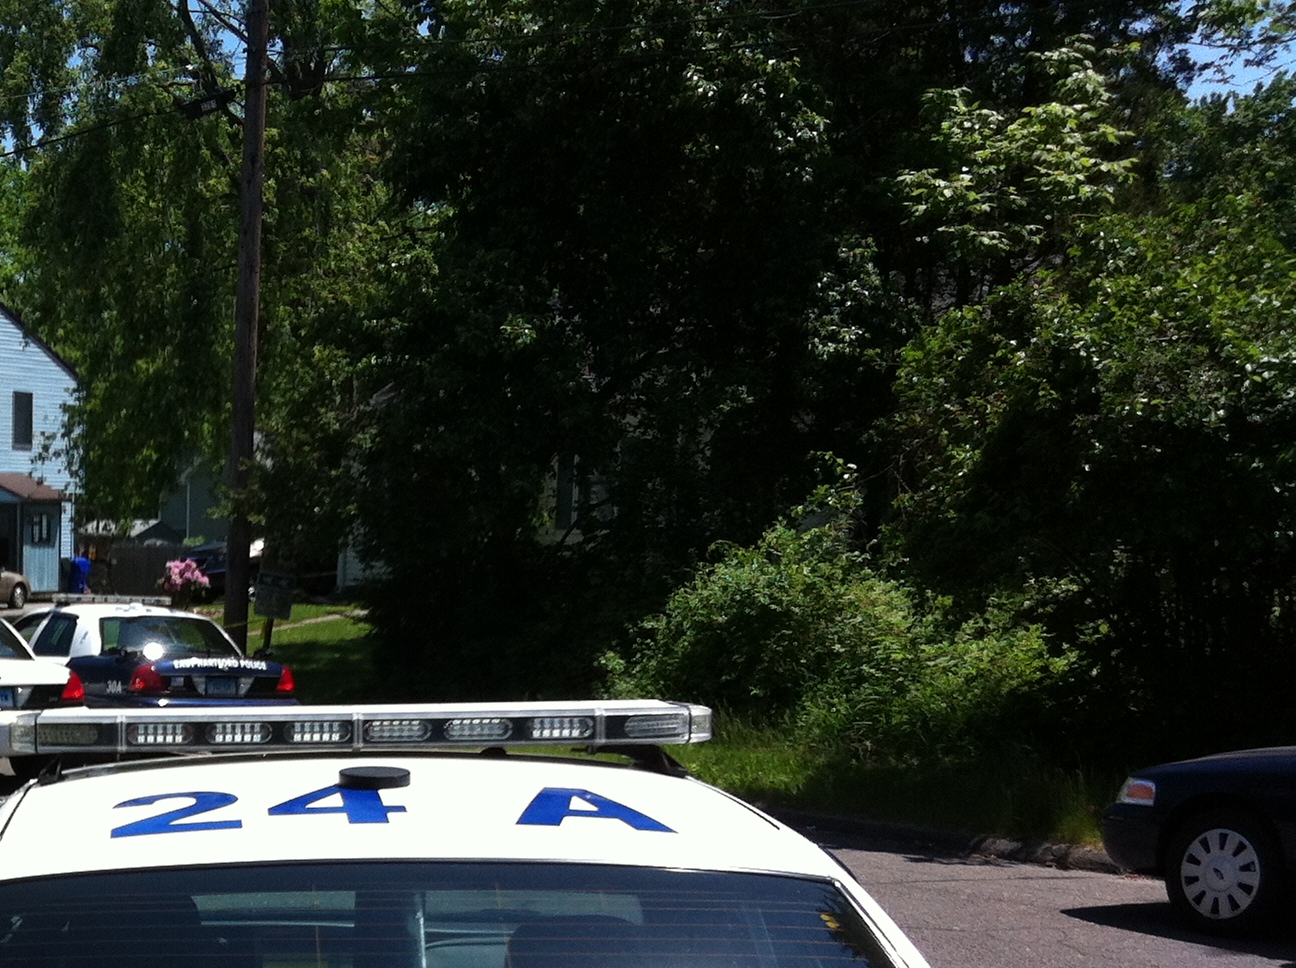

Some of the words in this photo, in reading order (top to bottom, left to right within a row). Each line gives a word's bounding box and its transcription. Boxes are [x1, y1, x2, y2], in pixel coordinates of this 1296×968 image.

[106, 679, 122, 694] 30A
[110, 783, 407, 838] 24
[515, 786, 679, 834] A
